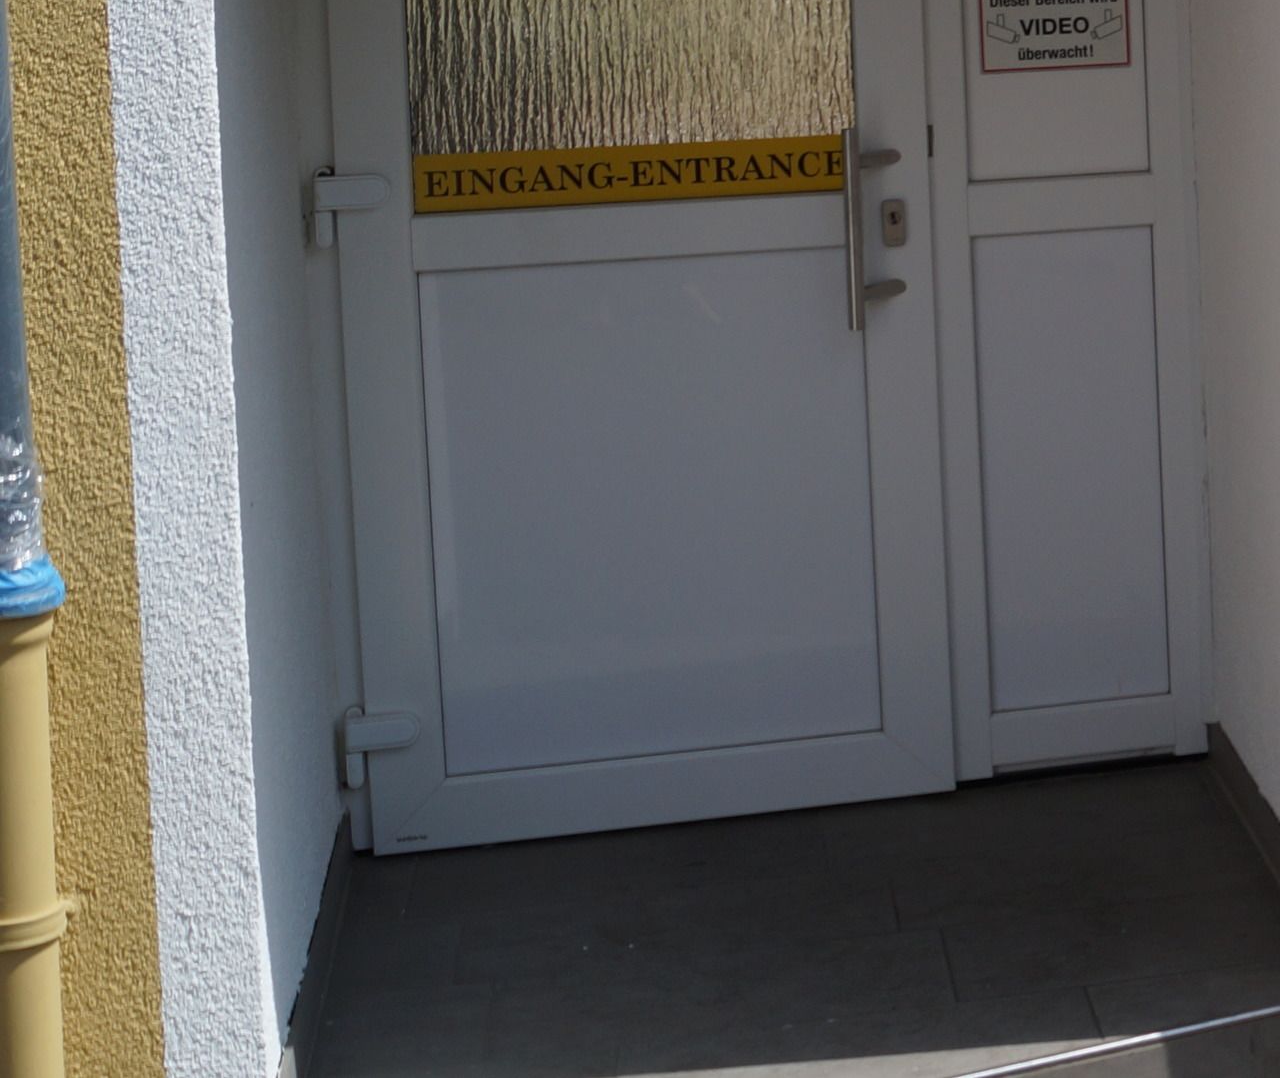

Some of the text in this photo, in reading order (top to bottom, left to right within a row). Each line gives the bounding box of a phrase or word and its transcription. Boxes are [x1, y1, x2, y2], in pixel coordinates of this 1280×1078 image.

[1019, 16, 1090, 36] VIDEO
[1018, 44, 1094, 61] überwacht!
[423, 150, 844, 199] EINGANG-ENTRANCE
